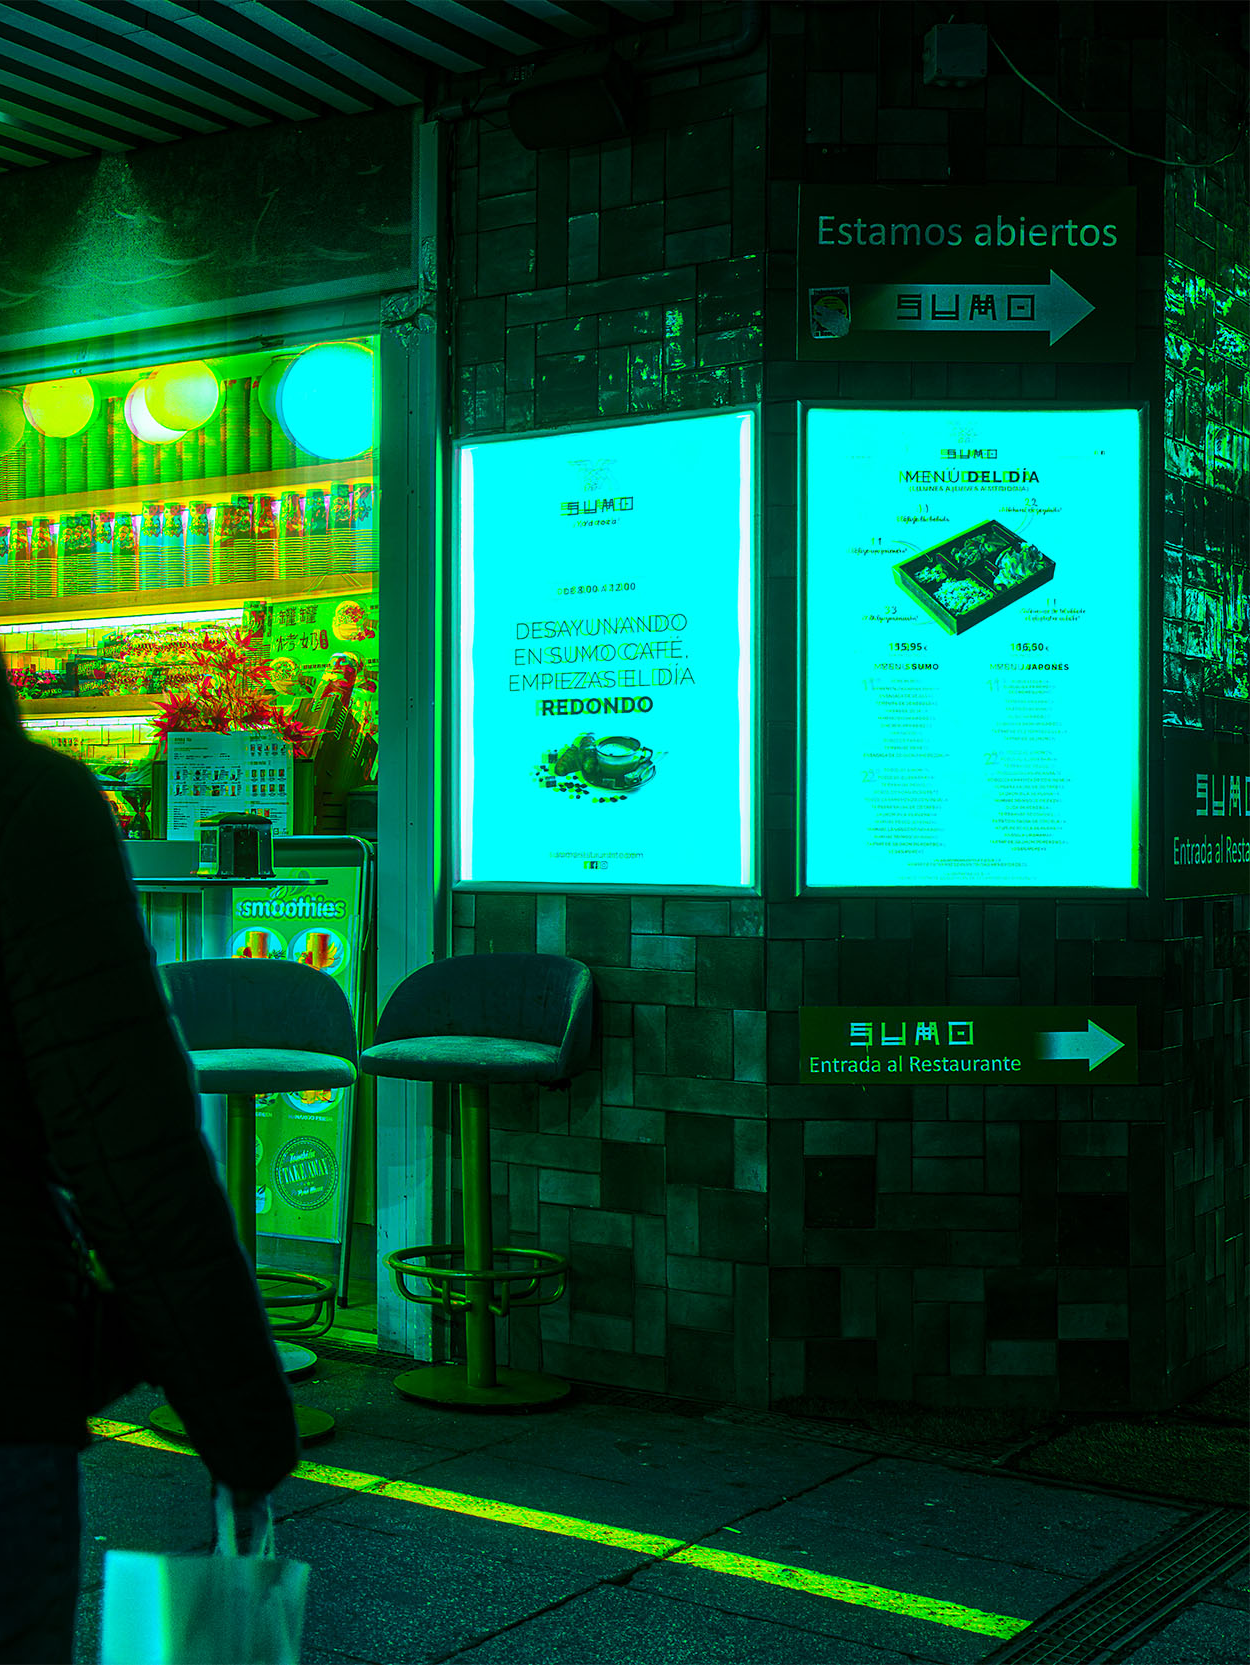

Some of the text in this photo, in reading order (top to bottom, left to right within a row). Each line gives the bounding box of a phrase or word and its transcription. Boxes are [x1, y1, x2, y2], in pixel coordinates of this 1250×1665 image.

[817, 214, 1118, 247] Estamos abiertos
[896, 293, 1035, 321] SUMO
[944, 448, 998, 459] SUMO
[967, 470, 1003, 483] DEL
[1008, 466, 1040, 483] DÍA
[565, 496, 634, 516] SUMO
[515, 612, 688, 640] DESAYUNANDO
[514, 647, 542, 666] EN
[549, 643, 617, 665] SUMO
[508, 661, 696, 692] EMPIEZAS EL DÍA
[911, 663, 939, 671] SUMO
[540, 695, 654, 716] REDONDO
[1173, 834, 1213, 865] Entrada
[1215, 833, 1224, 864] al
[239, 894, 347, 919] smoothies
[849, 1020, 974, 1046] SUMO
[809, 1054, 1022, 1074] Entrada al Restaurante
